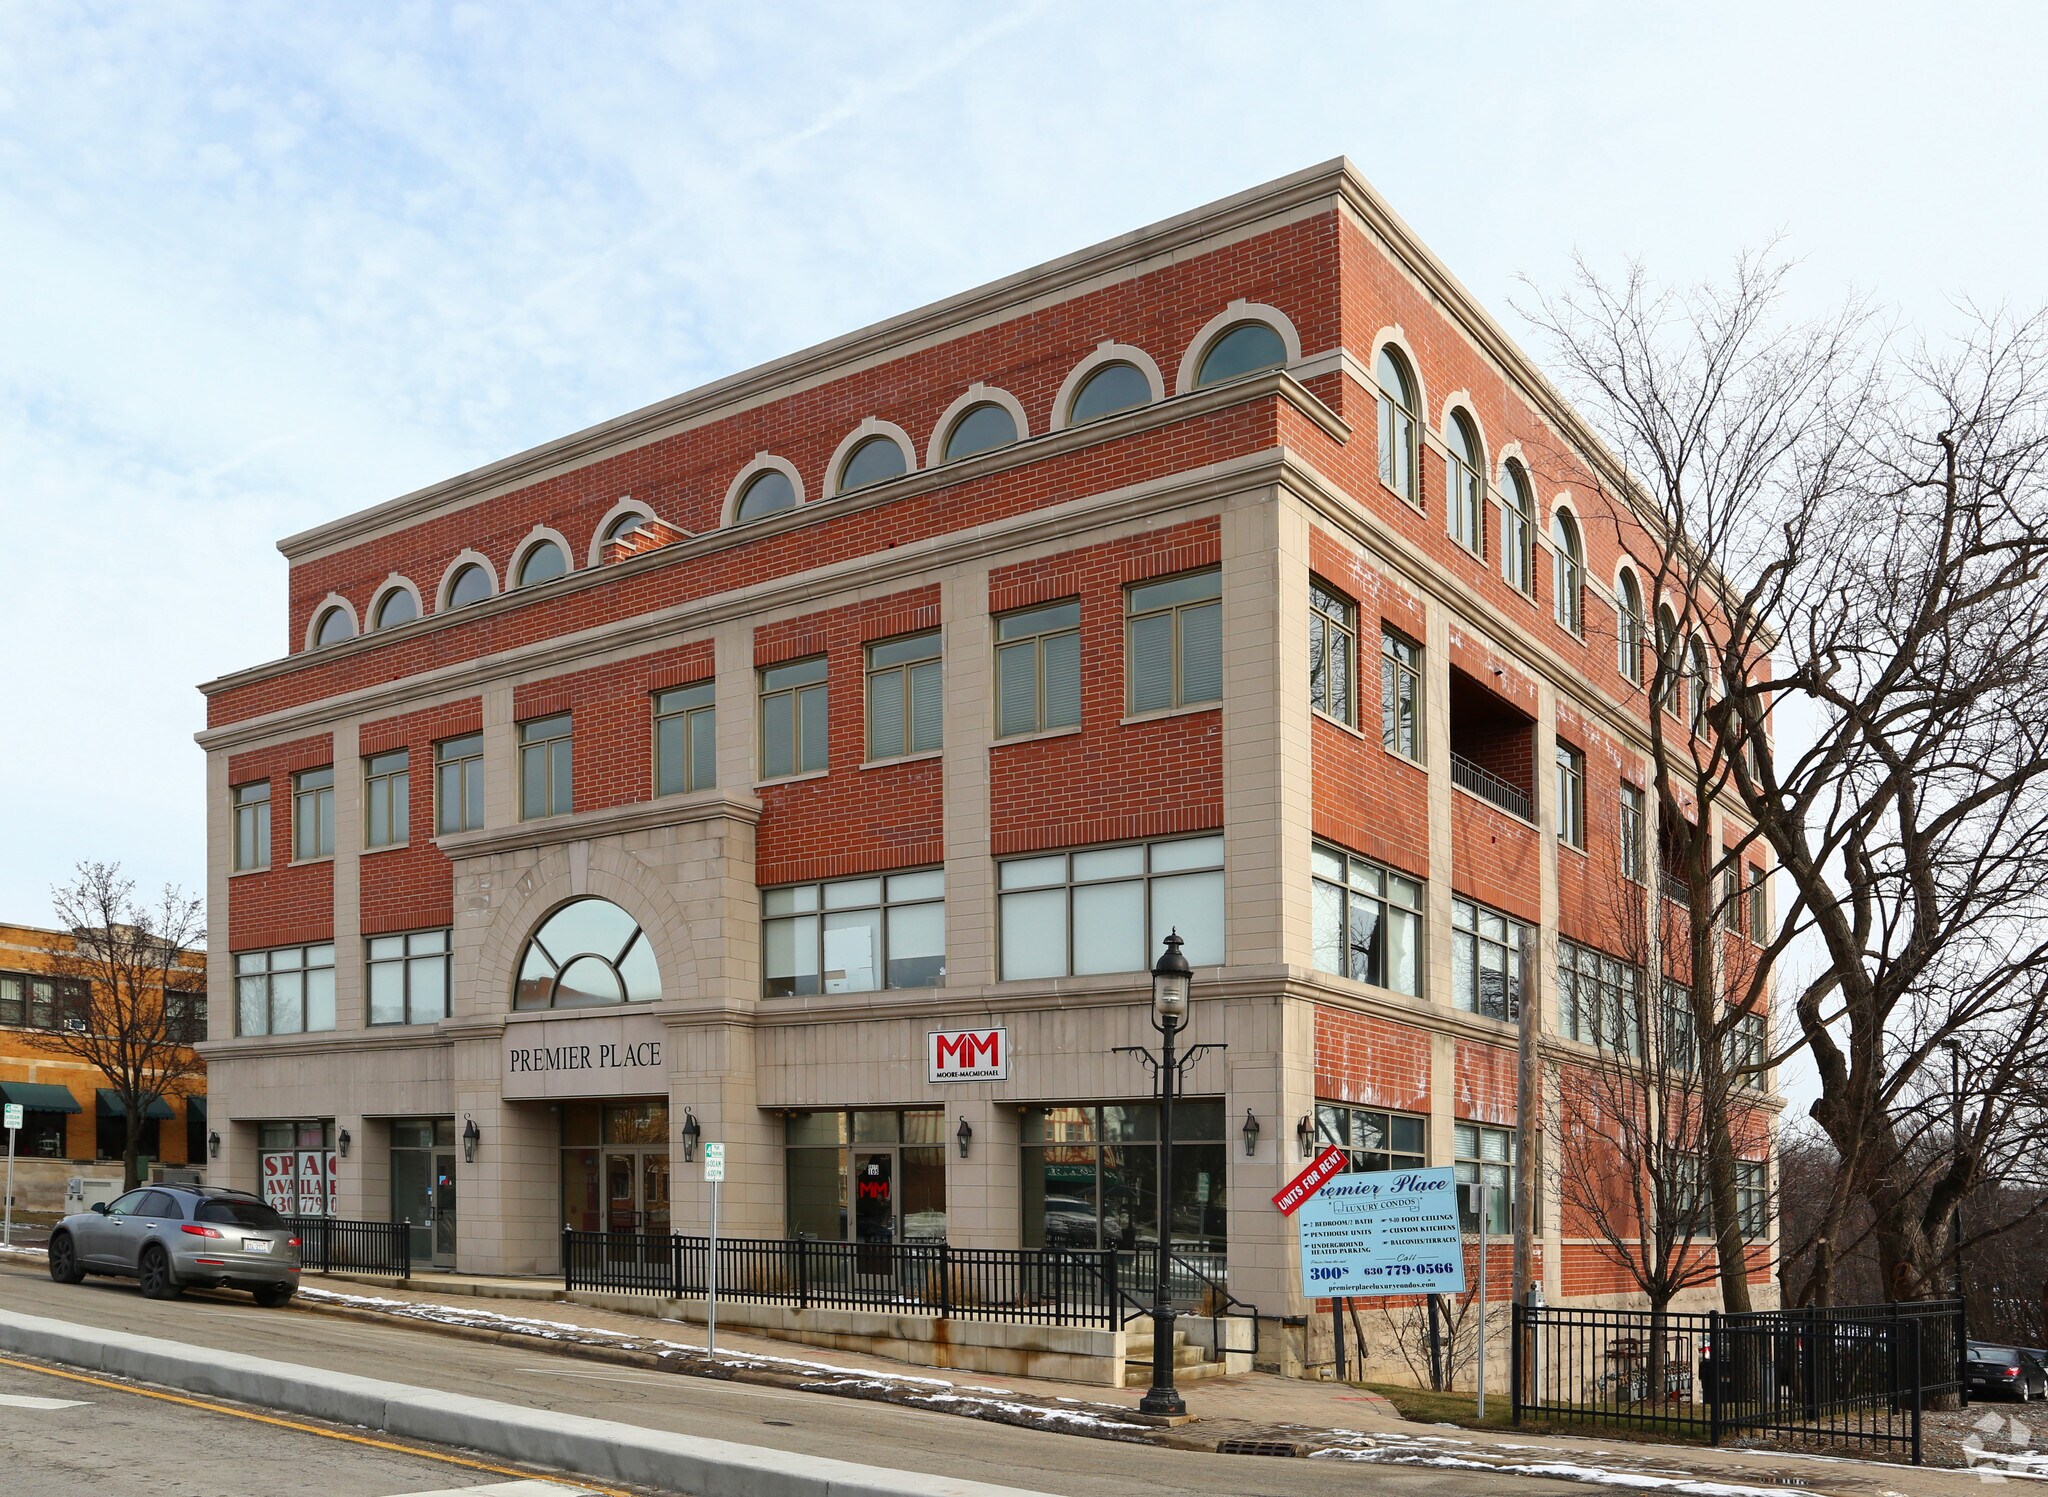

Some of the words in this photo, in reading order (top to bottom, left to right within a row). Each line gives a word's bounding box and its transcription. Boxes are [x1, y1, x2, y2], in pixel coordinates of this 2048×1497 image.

[510, 1046, 592, 1072] PREMIER
[599, 1043, 662, 1068] PLACE
[936, 1070, 999, 1078] MOORE-MACMICHAEL
[1278, 1185, 1304, 1211] UNITS
[1302, 1170, 1321, 1190] FOR
[1318, 1150, 1341, 1175] RENT
[1319, 1183, 1383, 1197] remier
[1390, 1174, 1449, 1193] Place
[301, 1196, 322, 1212] 779
[1346, 1203, 1378, 1212] LUXURY
[1381, 1199, 1415, 1209] CONDOS
[1311, 1241, 1364, 1249] UNDERGROUND
[1391, 1237, 1456, 1245] BALCONIES/TERRACES
[1397, 1254, 1417, 1262] Call
[1328, 1282, 1436, 1292] premierplaceluxurycondos.com
